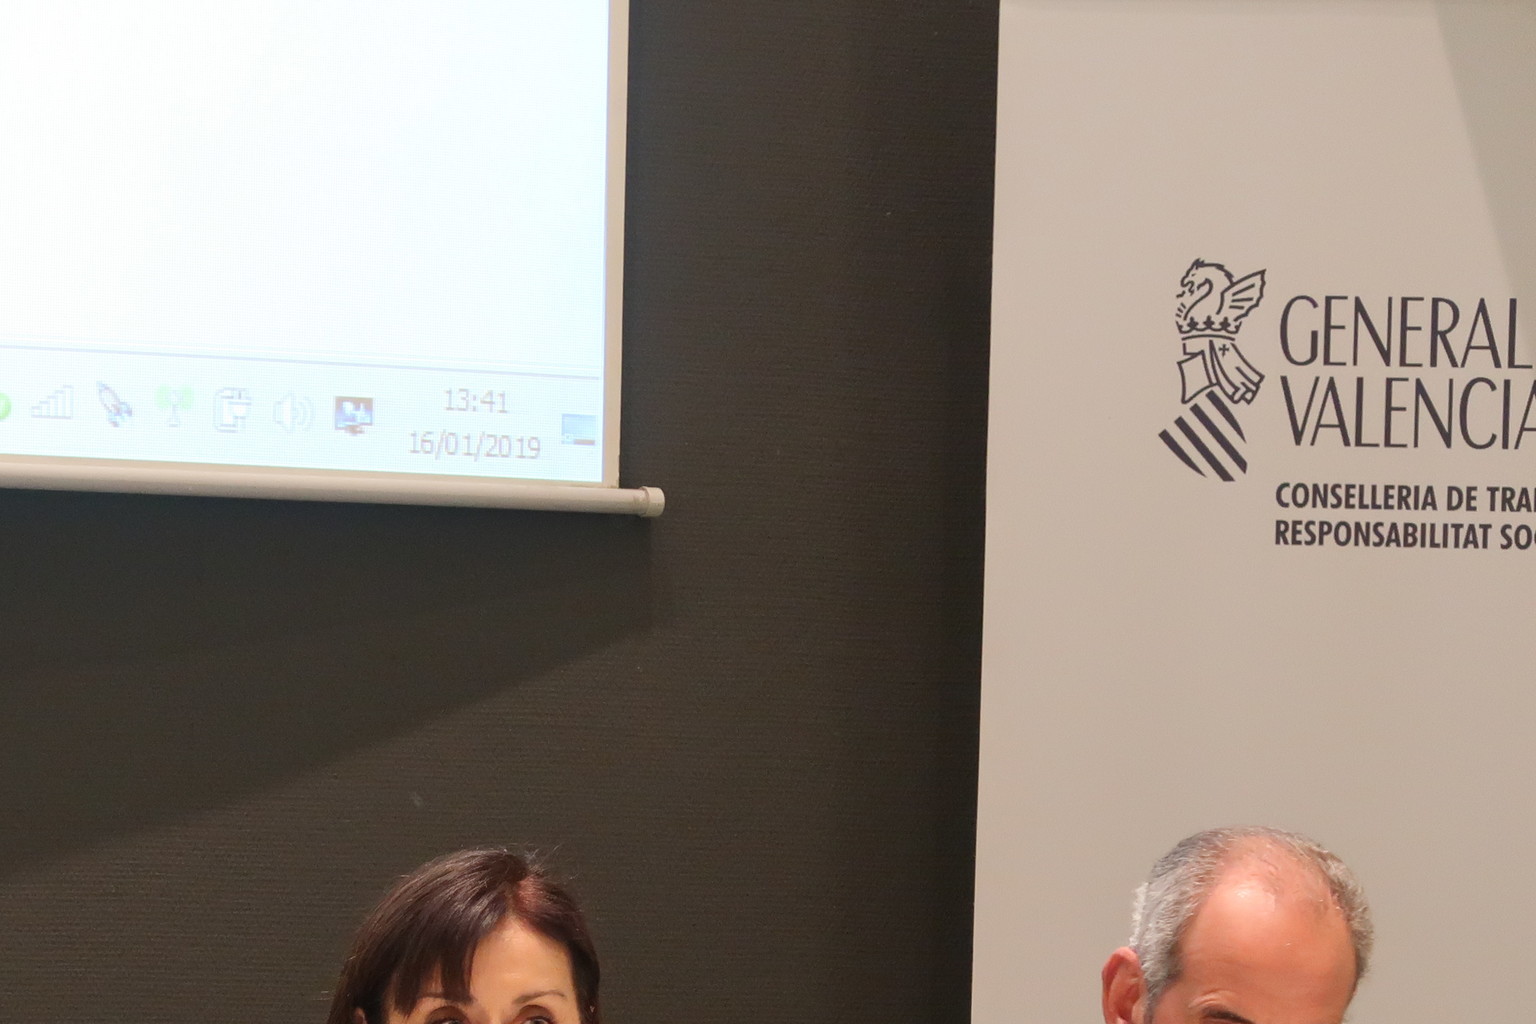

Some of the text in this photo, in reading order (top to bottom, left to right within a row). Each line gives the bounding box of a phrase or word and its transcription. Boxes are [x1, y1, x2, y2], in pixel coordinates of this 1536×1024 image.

[1279, 294, 1534, 369] GENERAL
[443, 387, 509, 415] 13:41
[408, 428, 542, 462] 16/01/2019
[1275, 482, 1536, 513] CONSELLERIA DE TRA
[1274, 519, 1536, 551] RESPONSABILITAT SO
